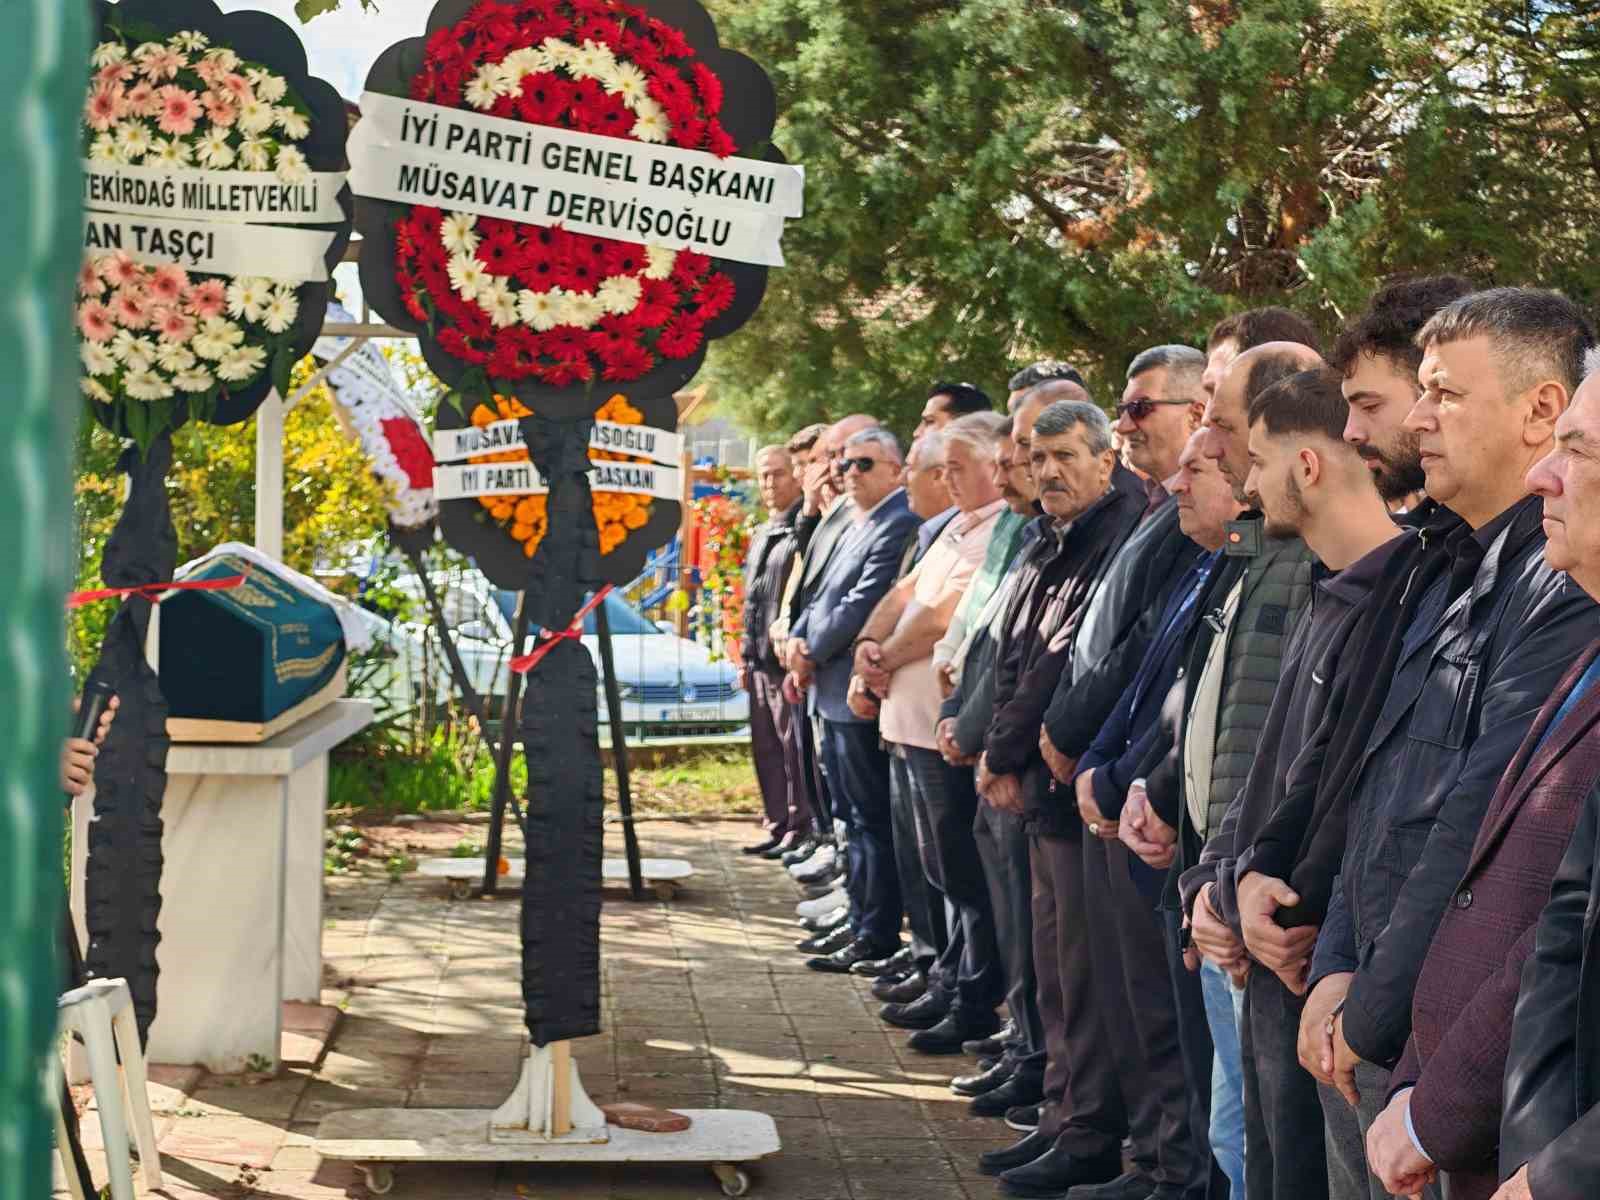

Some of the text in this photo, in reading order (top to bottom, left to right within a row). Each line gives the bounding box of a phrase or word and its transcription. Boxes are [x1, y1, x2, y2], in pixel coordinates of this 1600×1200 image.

[401, 108, 775, 204] İYİ PARTİ GENEL BAŞKANI
[85, 221, 213, 266] AN TAŞÇI
[398, 163, 731, 247] MÜSAVAT DERVİŞOĞLU
